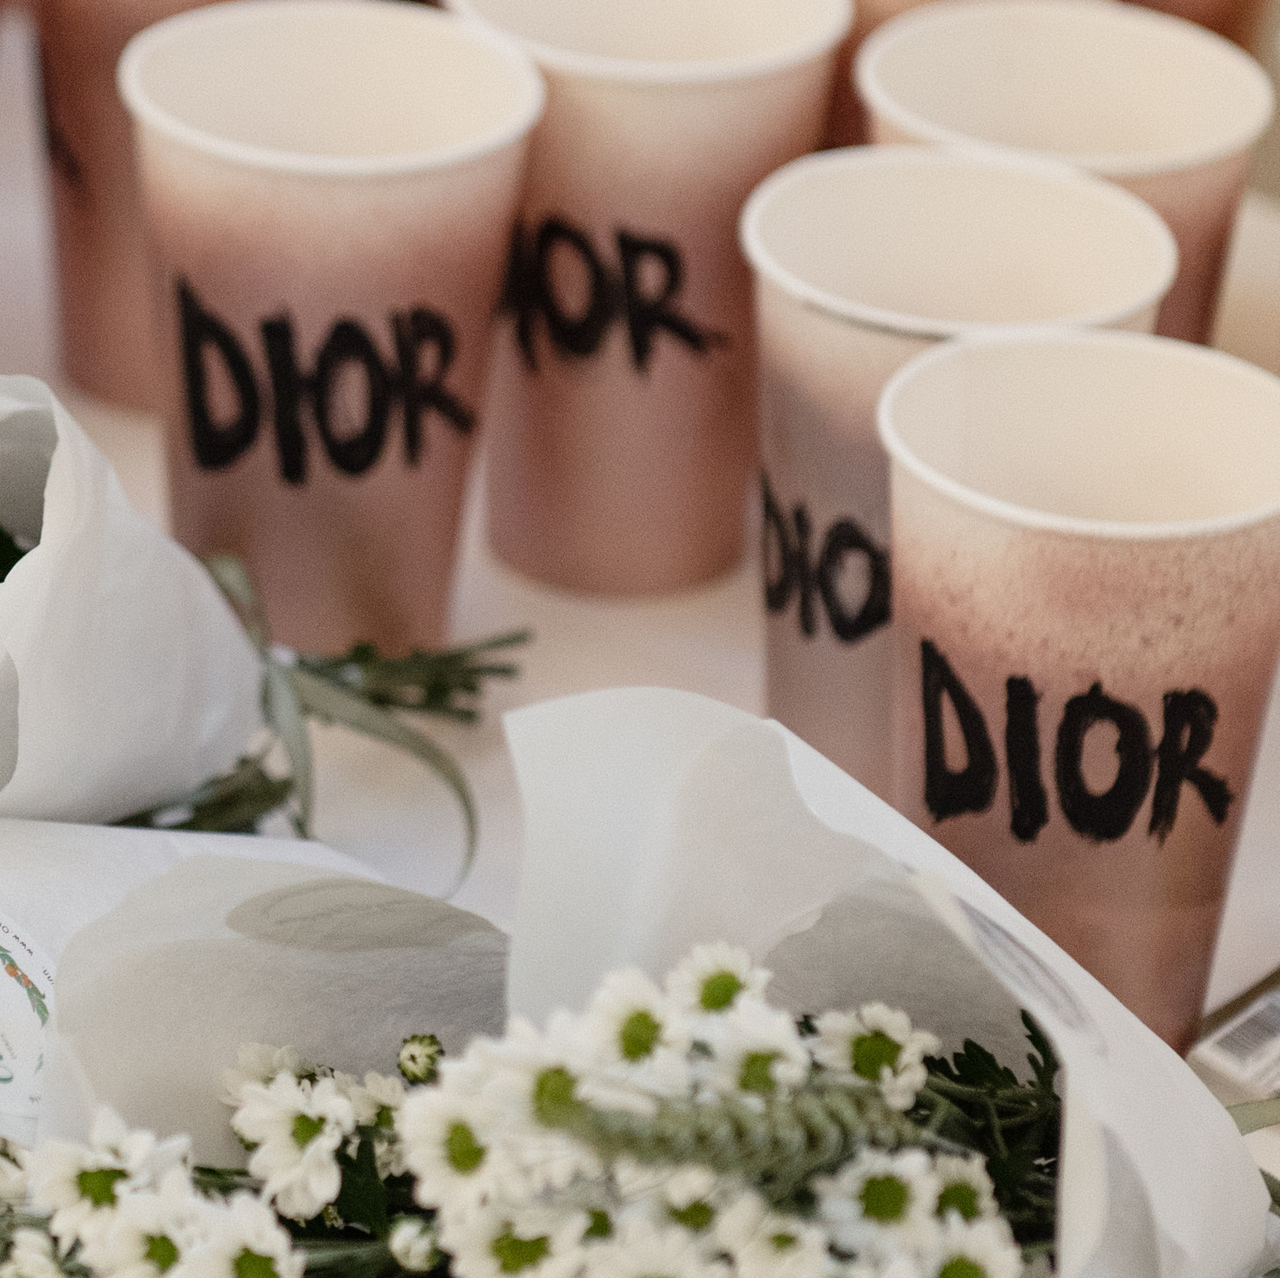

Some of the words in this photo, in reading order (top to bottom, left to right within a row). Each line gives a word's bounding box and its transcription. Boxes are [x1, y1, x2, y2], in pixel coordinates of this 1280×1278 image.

[176, 275, 476, 486] DIOR
[504, 214, 728, 372] IOR
[762, 472, 891, 643] DIO
[921, 639, 1233, 847] DIOR
